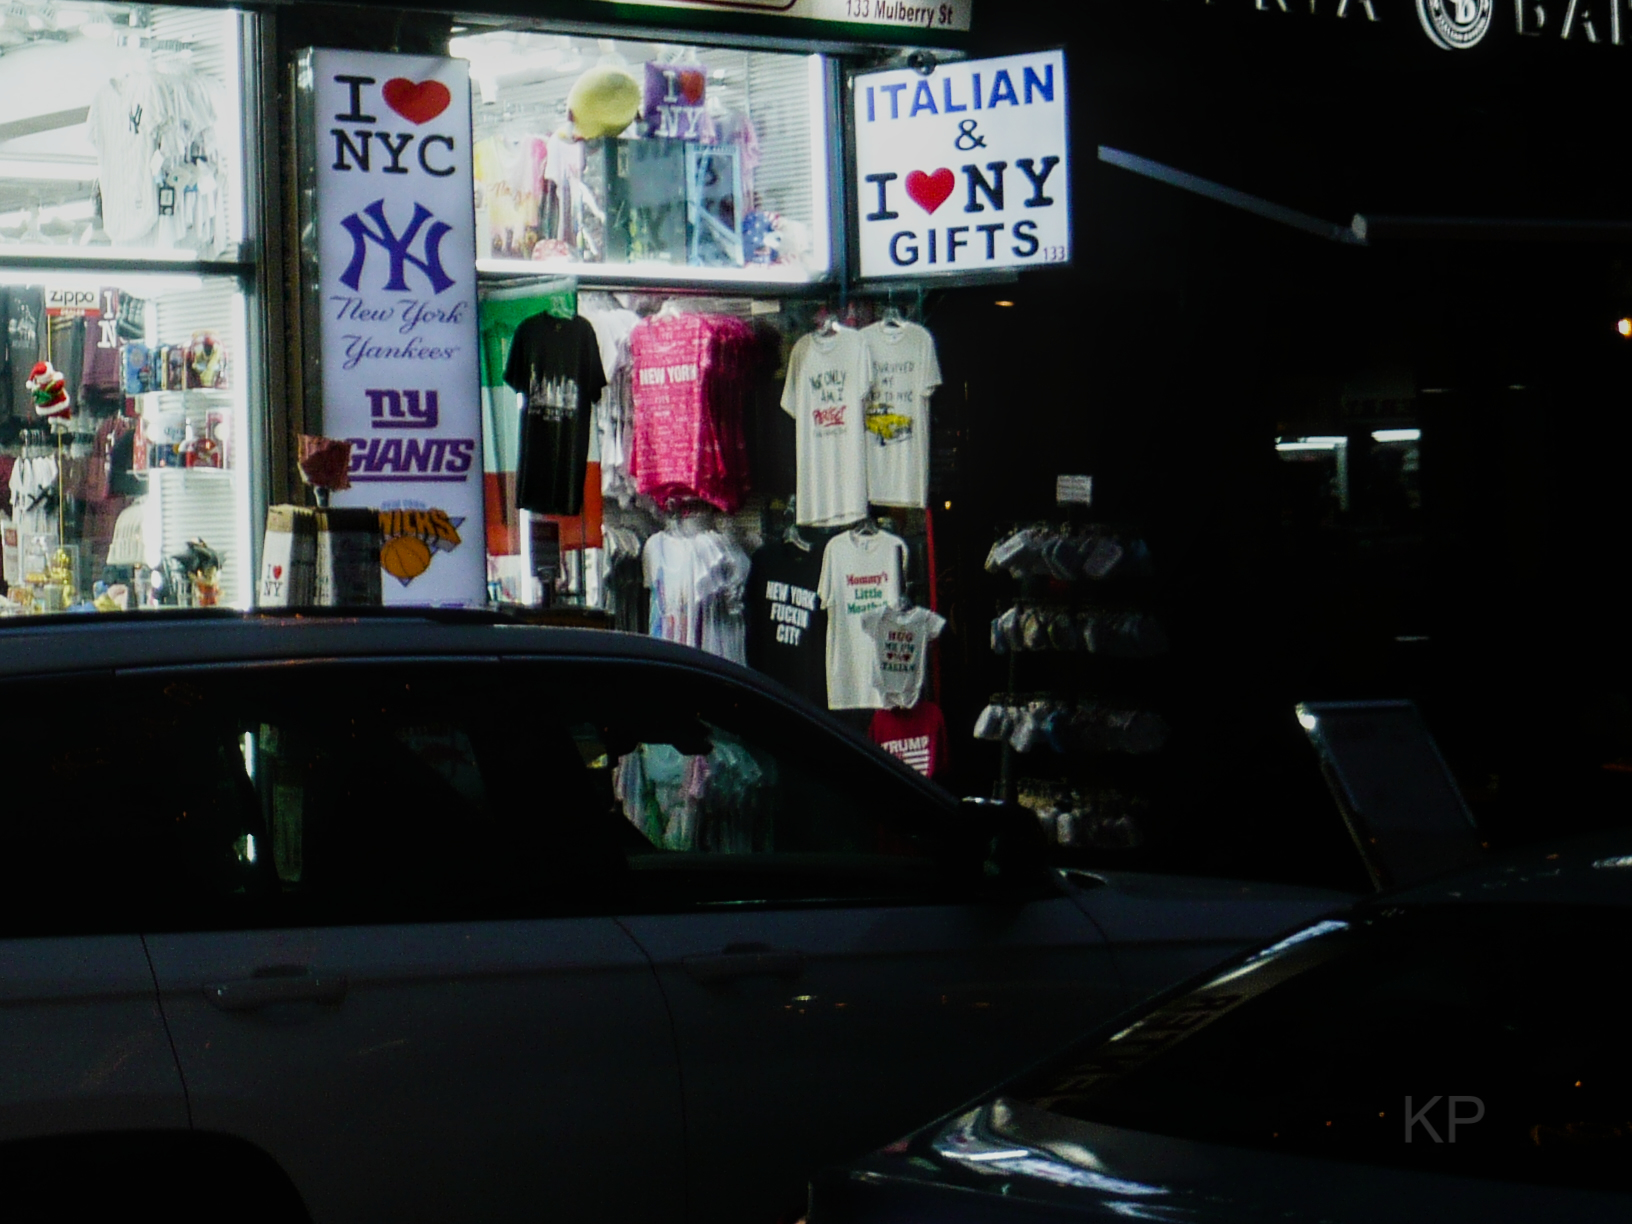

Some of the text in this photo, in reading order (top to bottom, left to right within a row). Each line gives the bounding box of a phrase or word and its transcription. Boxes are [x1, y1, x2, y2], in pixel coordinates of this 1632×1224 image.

[874, 0, 934, 28] Mulberry
[939, 2, 953, 25] St
[333, 73, 377, 124] I
[663, 70, 677, 104] I
[866, 64, 1055, 122] ITALIAN
[654, 105, 704, 137] NY
[954, 119, 987, 151] &
[331, 129, 456, 176] NYC
[865, 155, 1060, 222] I NY
[339, 197, 456, 296] NY
[889, 220, 1039, 267] GIFTS
[1043, 245, 1066, 261] 133
[49, 288, 95, 306] zippo
[330, 296, 464, 337] New York
[341, 332, 460, 370] Yankees
[639, 363, 699, 386] NEW YORK
[345, 437, 475, 474] GIANTS
[378, 507, 461, 546] NICKS
[766, 580, 817, 611] NEW YORK
[855, 588, 882, 599] Little
[776, 624, 801, 647] CITY
[881, 735, 930, 754] TRUMP
